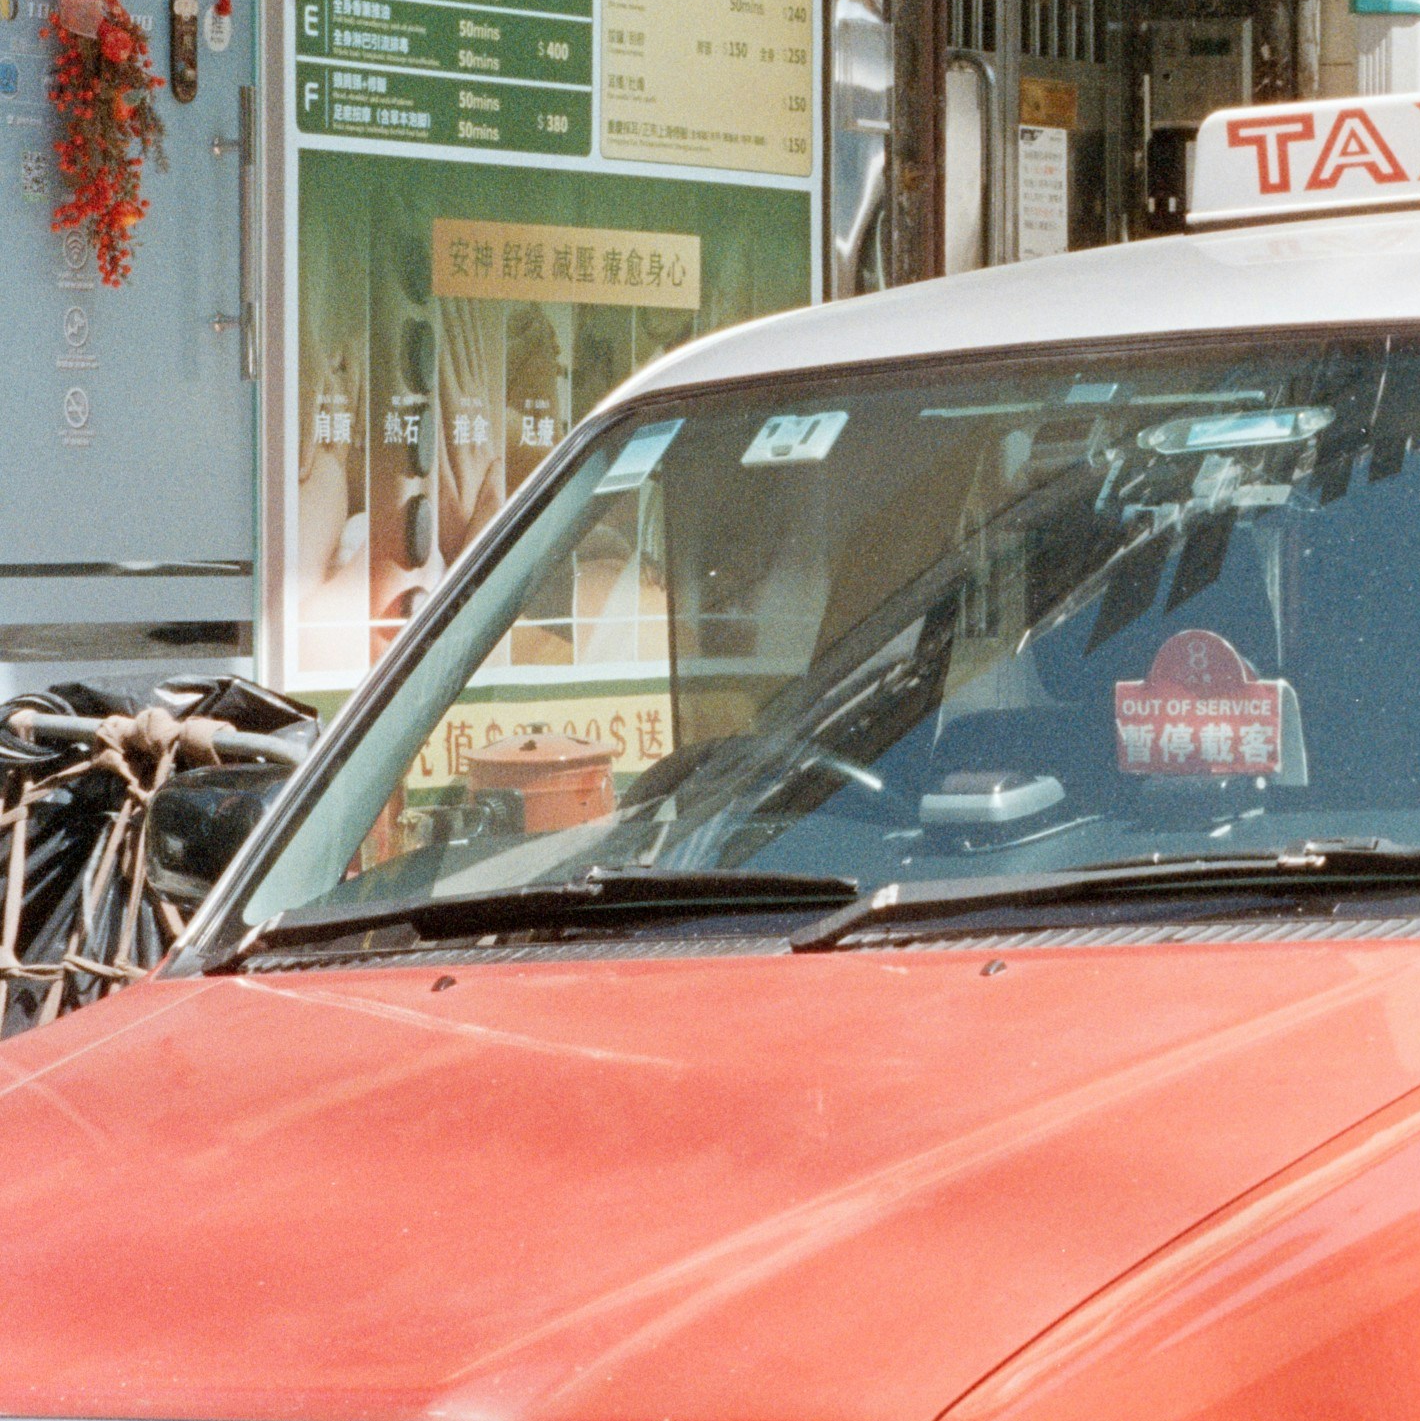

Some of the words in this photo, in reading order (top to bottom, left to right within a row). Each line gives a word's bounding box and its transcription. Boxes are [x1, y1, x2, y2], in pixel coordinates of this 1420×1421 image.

[304, 4, 319, 38] E
[459, 20, 500, 41] 50mins
[459, 50, 500, 71] 50mins
[304, 81, 319, 112] F
[459, 91, 500, 111] 50mins
[459, 121, 500, 141] 50mins
[1122, 699, 1161, 715] OUT
[1166, 699, 1191, 715] OF
[1195, 699, 1271, 716] SERVICE
[1121, 722, 1275, 765] 暫停載客
